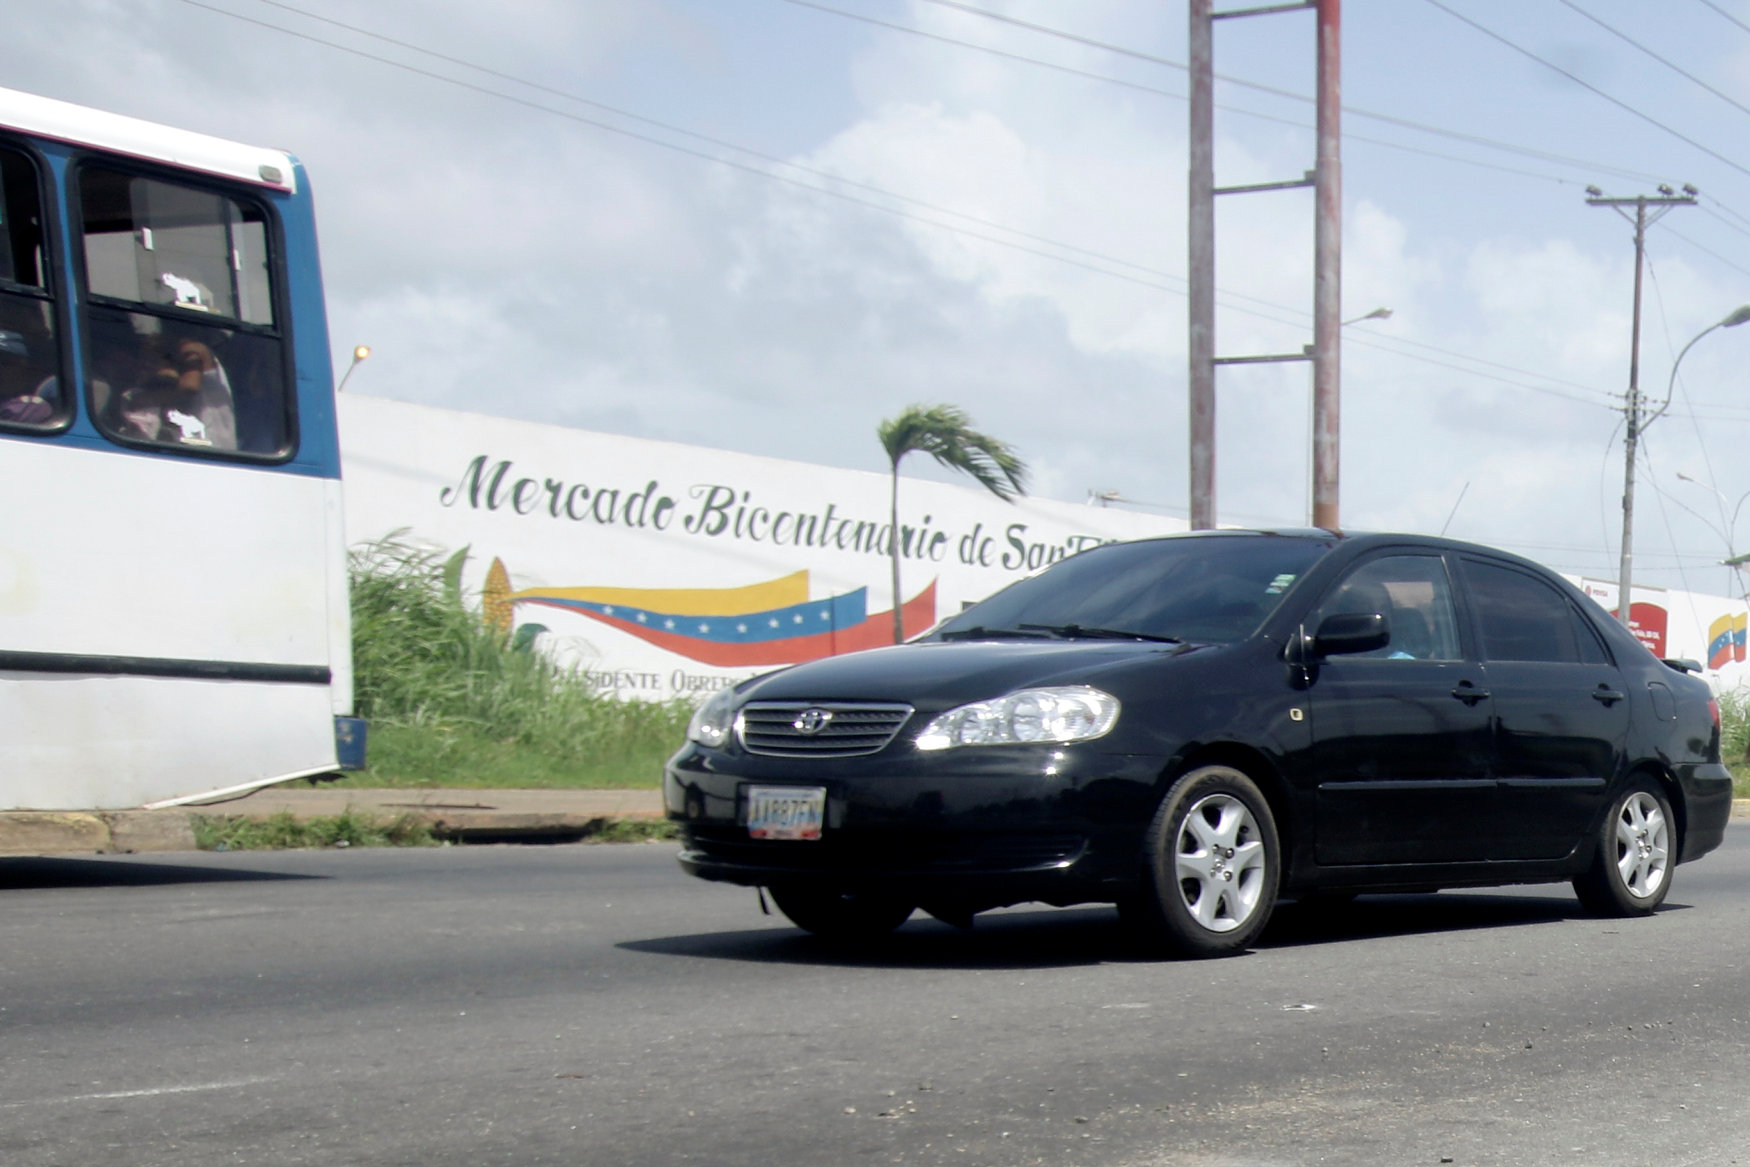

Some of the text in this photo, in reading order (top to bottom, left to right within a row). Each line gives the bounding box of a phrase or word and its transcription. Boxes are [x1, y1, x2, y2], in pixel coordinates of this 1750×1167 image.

[441, 455, 677, 530] Mercado
[684, 485, 948, 562] Bicentenario
[960, 523, 995, 567] de
